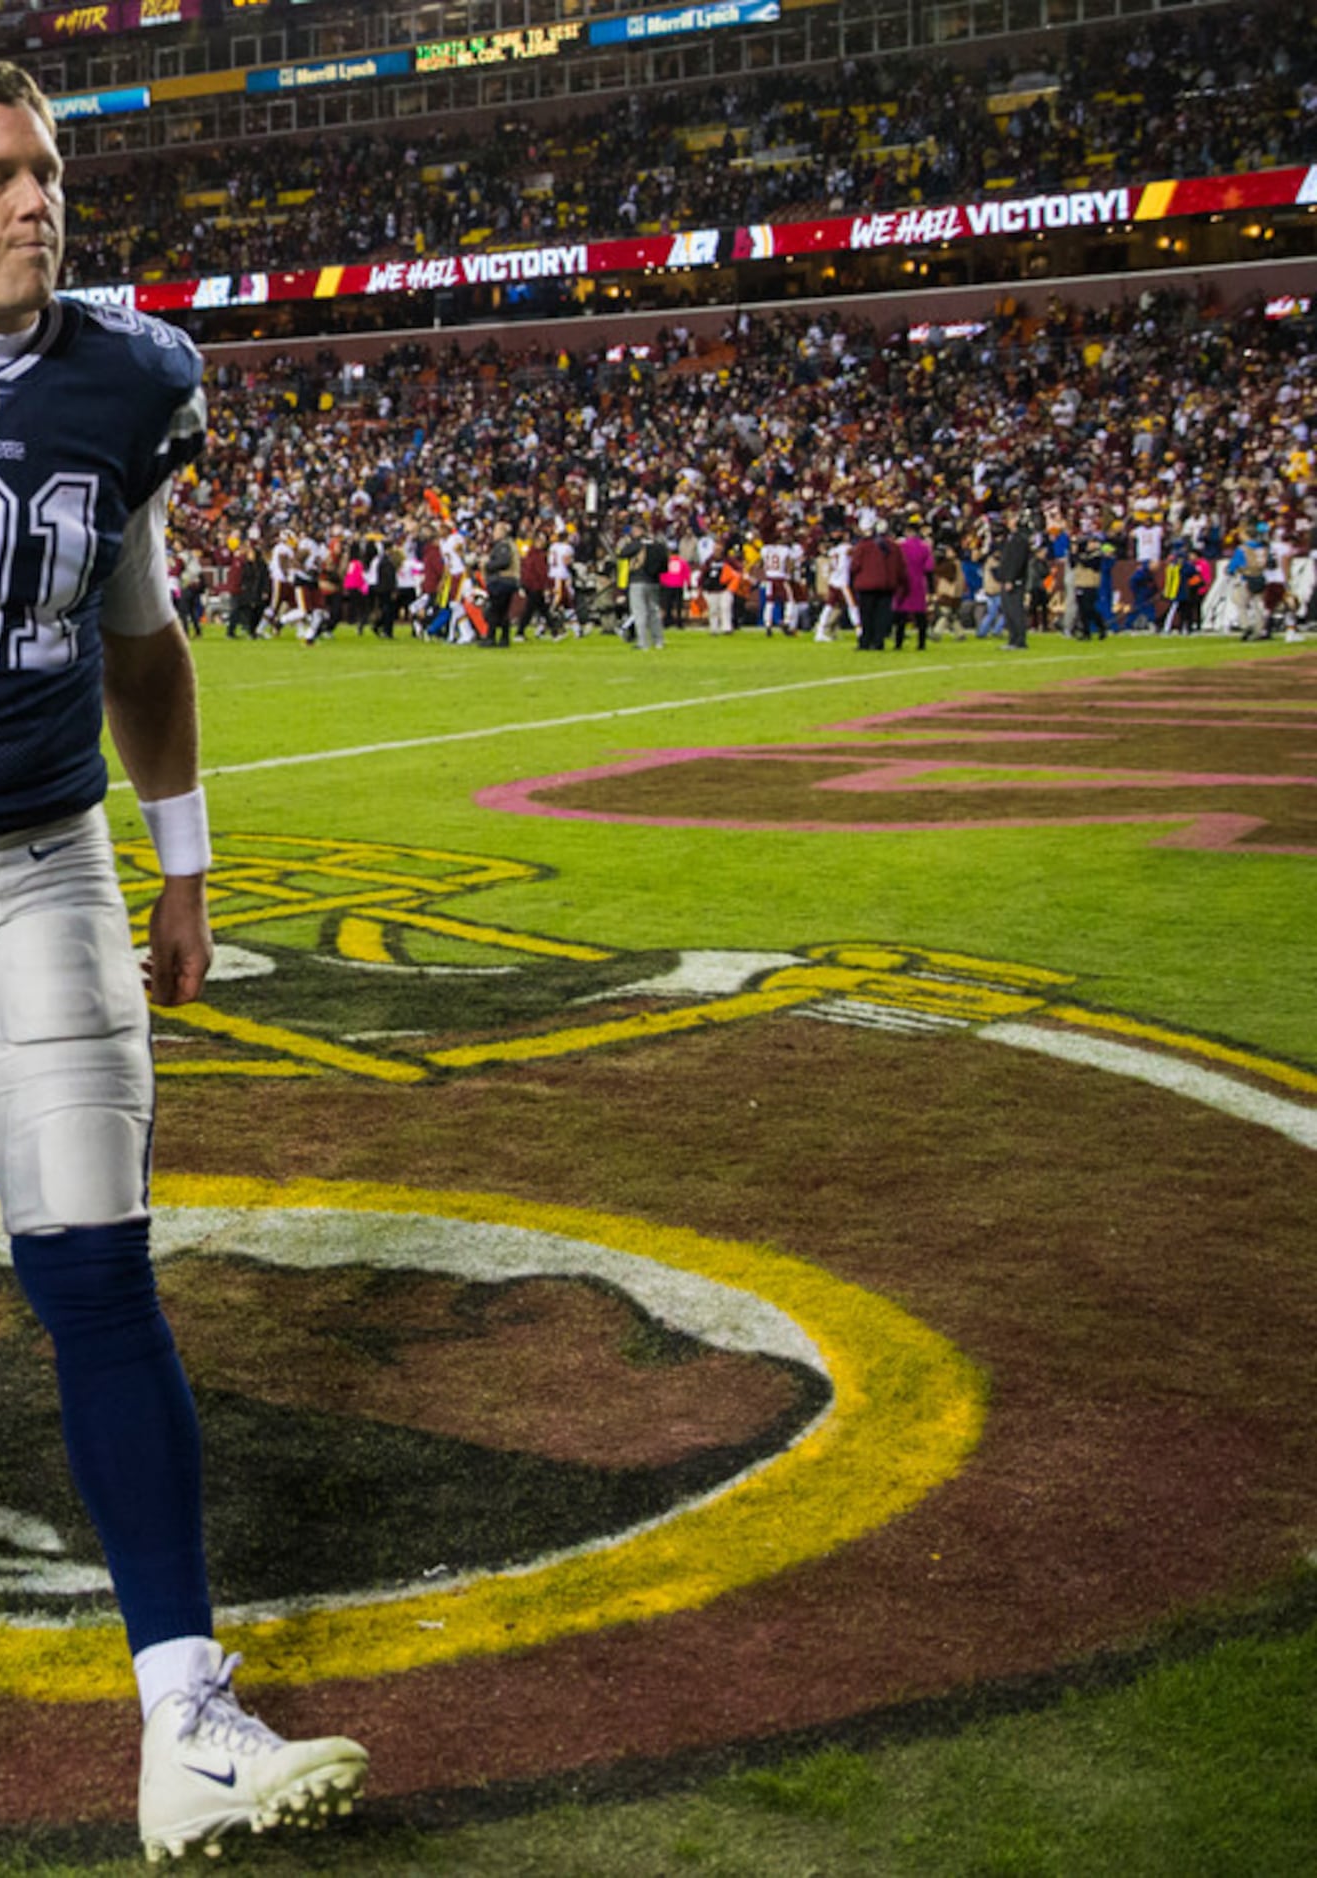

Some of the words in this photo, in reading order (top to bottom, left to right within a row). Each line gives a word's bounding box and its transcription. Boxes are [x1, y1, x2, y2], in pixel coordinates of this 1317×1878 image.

[646, 8, 694, 34] Merrill
[696, 4, 739, 29] Lynch
[295, 63, 337, 84] Merrill
[338, 58, 376, 80] Lynch
[849, 214, 896, 248] WE
[896, 205, 963, 245] HAIL
[965, 188, 1129, 234] VICTORY!
[365, 264, 405, 294] WE
[406, 256, 459, 290] HAIL
[461, 244, 588, 284] VICTORY!
